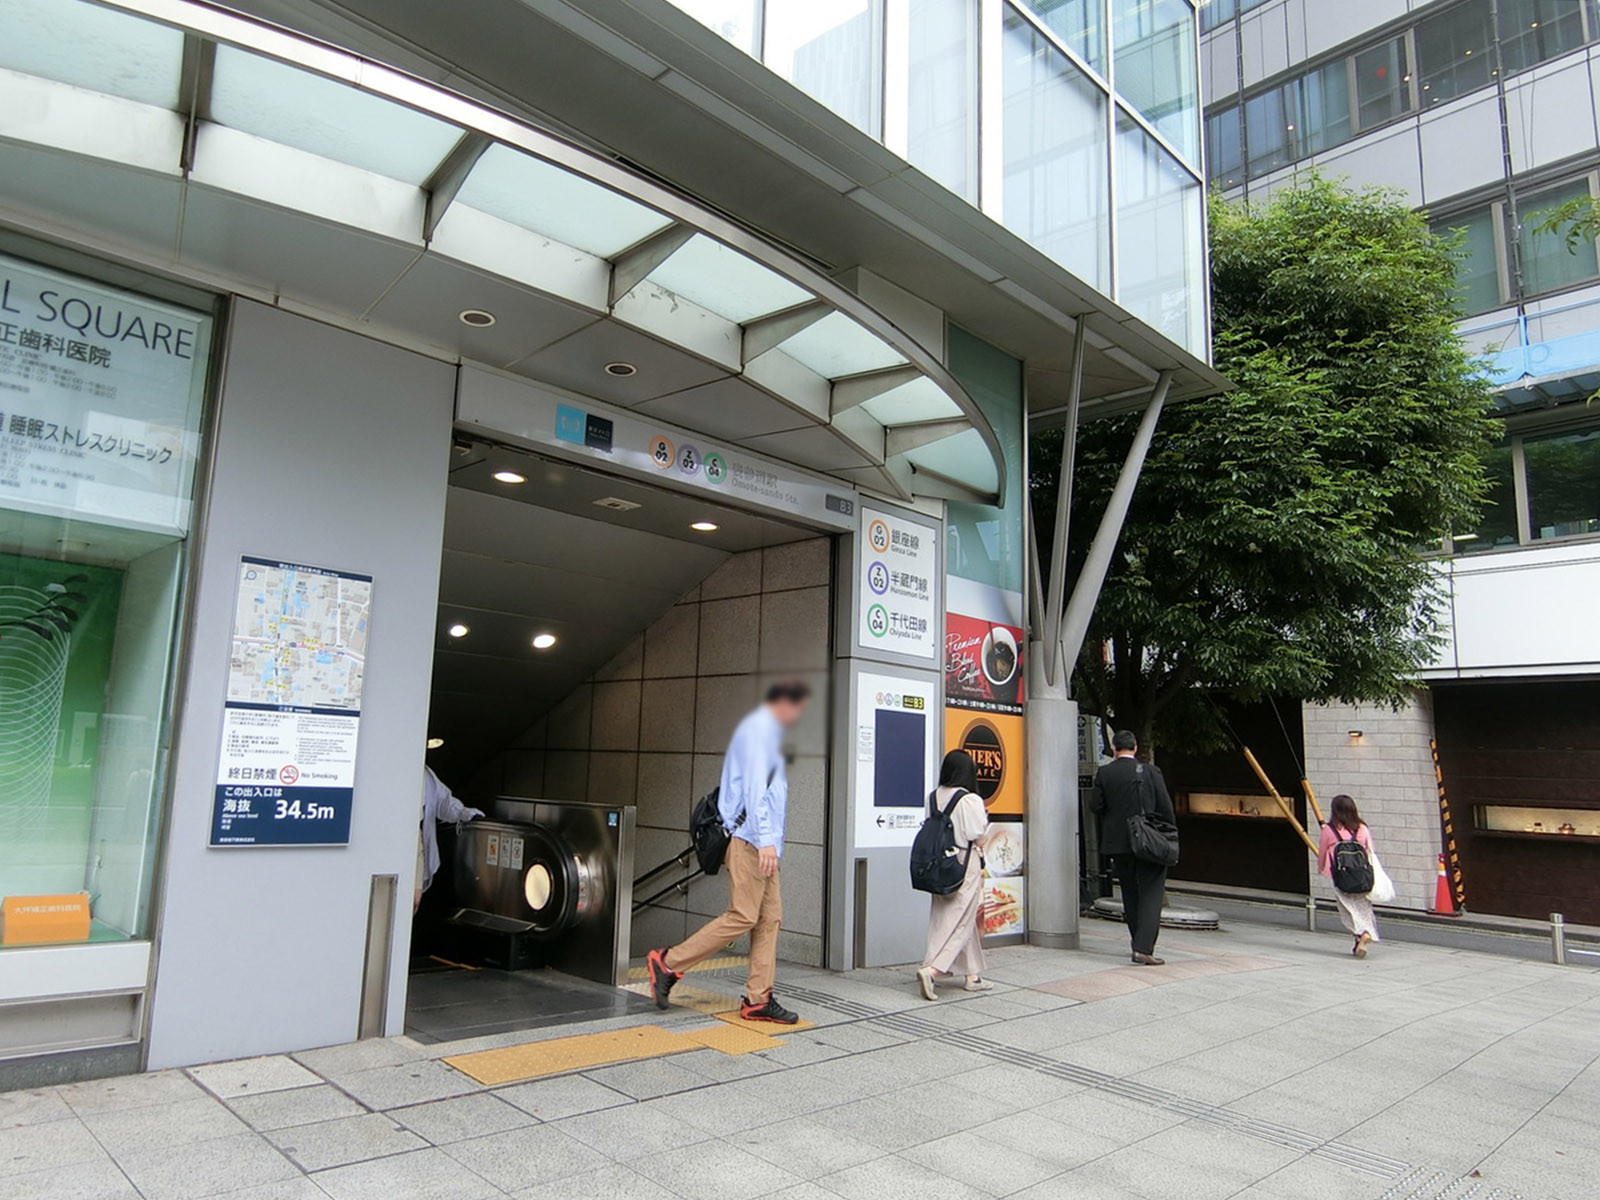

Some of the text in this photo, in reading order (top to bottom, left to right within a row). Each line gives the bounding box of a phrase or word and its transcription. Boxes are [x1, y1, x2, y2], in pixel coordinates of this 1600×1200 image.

[36, 290, 194, 360] SQUARE
[9, 414, 173, 465] 睡眠ストレスクリニック
[658, 441, 666, 451] G
[655, 450, 668, 462] 02
[686, 450, 692, 459] Z
[682, 458, 695, 470] 02
[711, 458, 718, 468] C
[708, 466, 720, 477] 04
[839, 501, 853, 514] B3
[876, 525, 883, 535] G
[874, 535, 885, 547] 02
[891, 528, 920, 550] 銀座線
[876, 567, 882, 577] Z
[873, 577, 884, 588] 02
[875, 609, 881, 619] C
[872, 619, 883, 630] 04
[890, 612, 928, 633] 千代田線
[913, 697, 924, 709] B3
[228, 766, 278, 781] 終日禁煙
[312, 772, 338, 781] Smoking
[225, 786, 283, 797] この出入口は
[222, 799, 251, 813] 海抜
[274, 799, 335, 820] 34.5m
